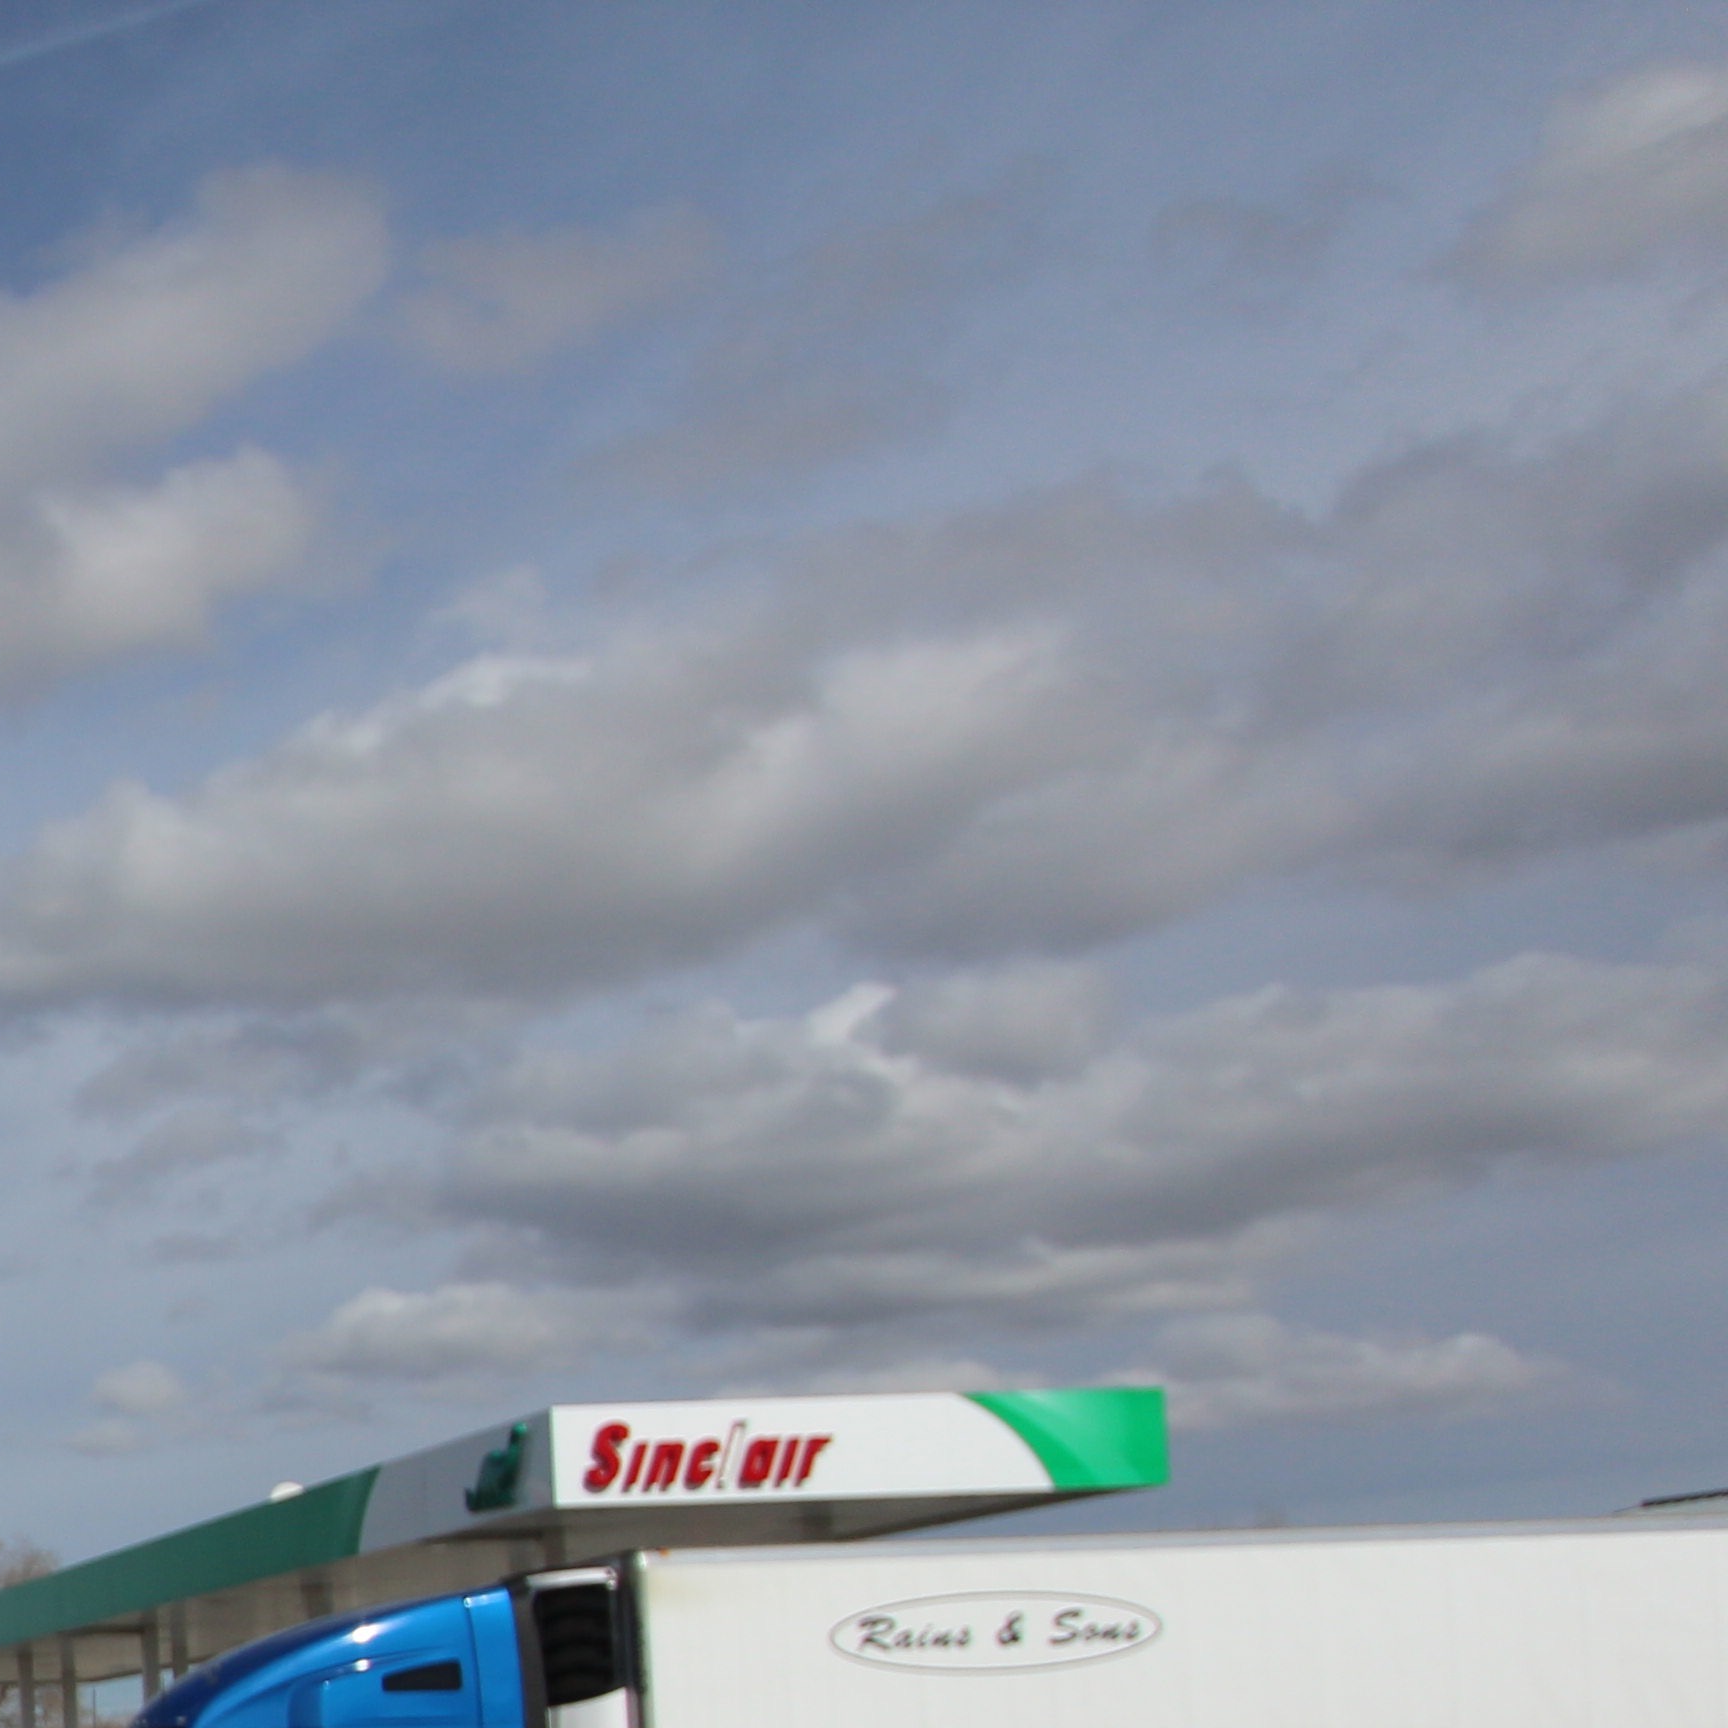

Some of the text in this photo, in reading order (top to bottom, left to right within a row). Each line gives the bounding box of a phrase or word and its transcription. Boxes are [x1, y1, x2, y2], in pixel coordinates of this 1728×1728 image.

[584, 1418, 833, 1493] Sinclair
[856, 1608, 1141, 1651] Rains & Sons
